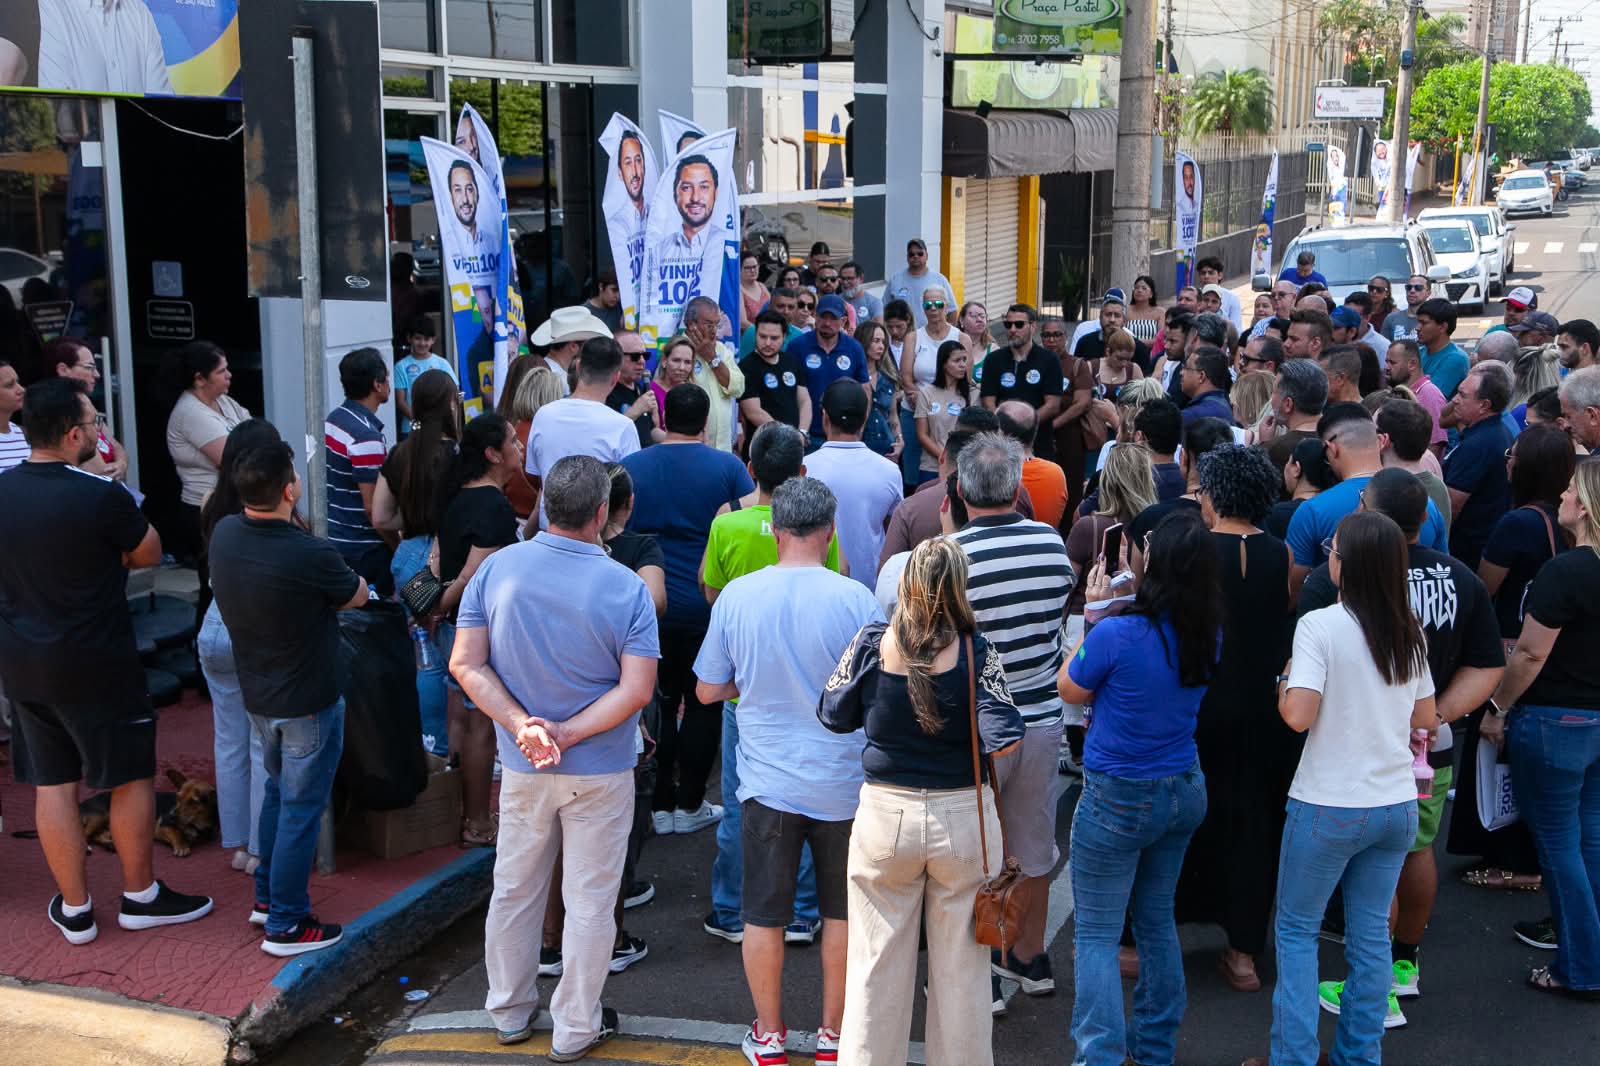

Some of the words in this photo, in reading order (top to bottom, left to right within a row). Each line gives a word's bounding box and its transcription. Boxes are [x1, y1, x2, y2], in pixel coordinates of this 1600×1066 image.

[1016, 34, 1038, 44] 3702
[1039, 34, 1061, 44] 7958
[1501, 773, 1512, 817] 1002
